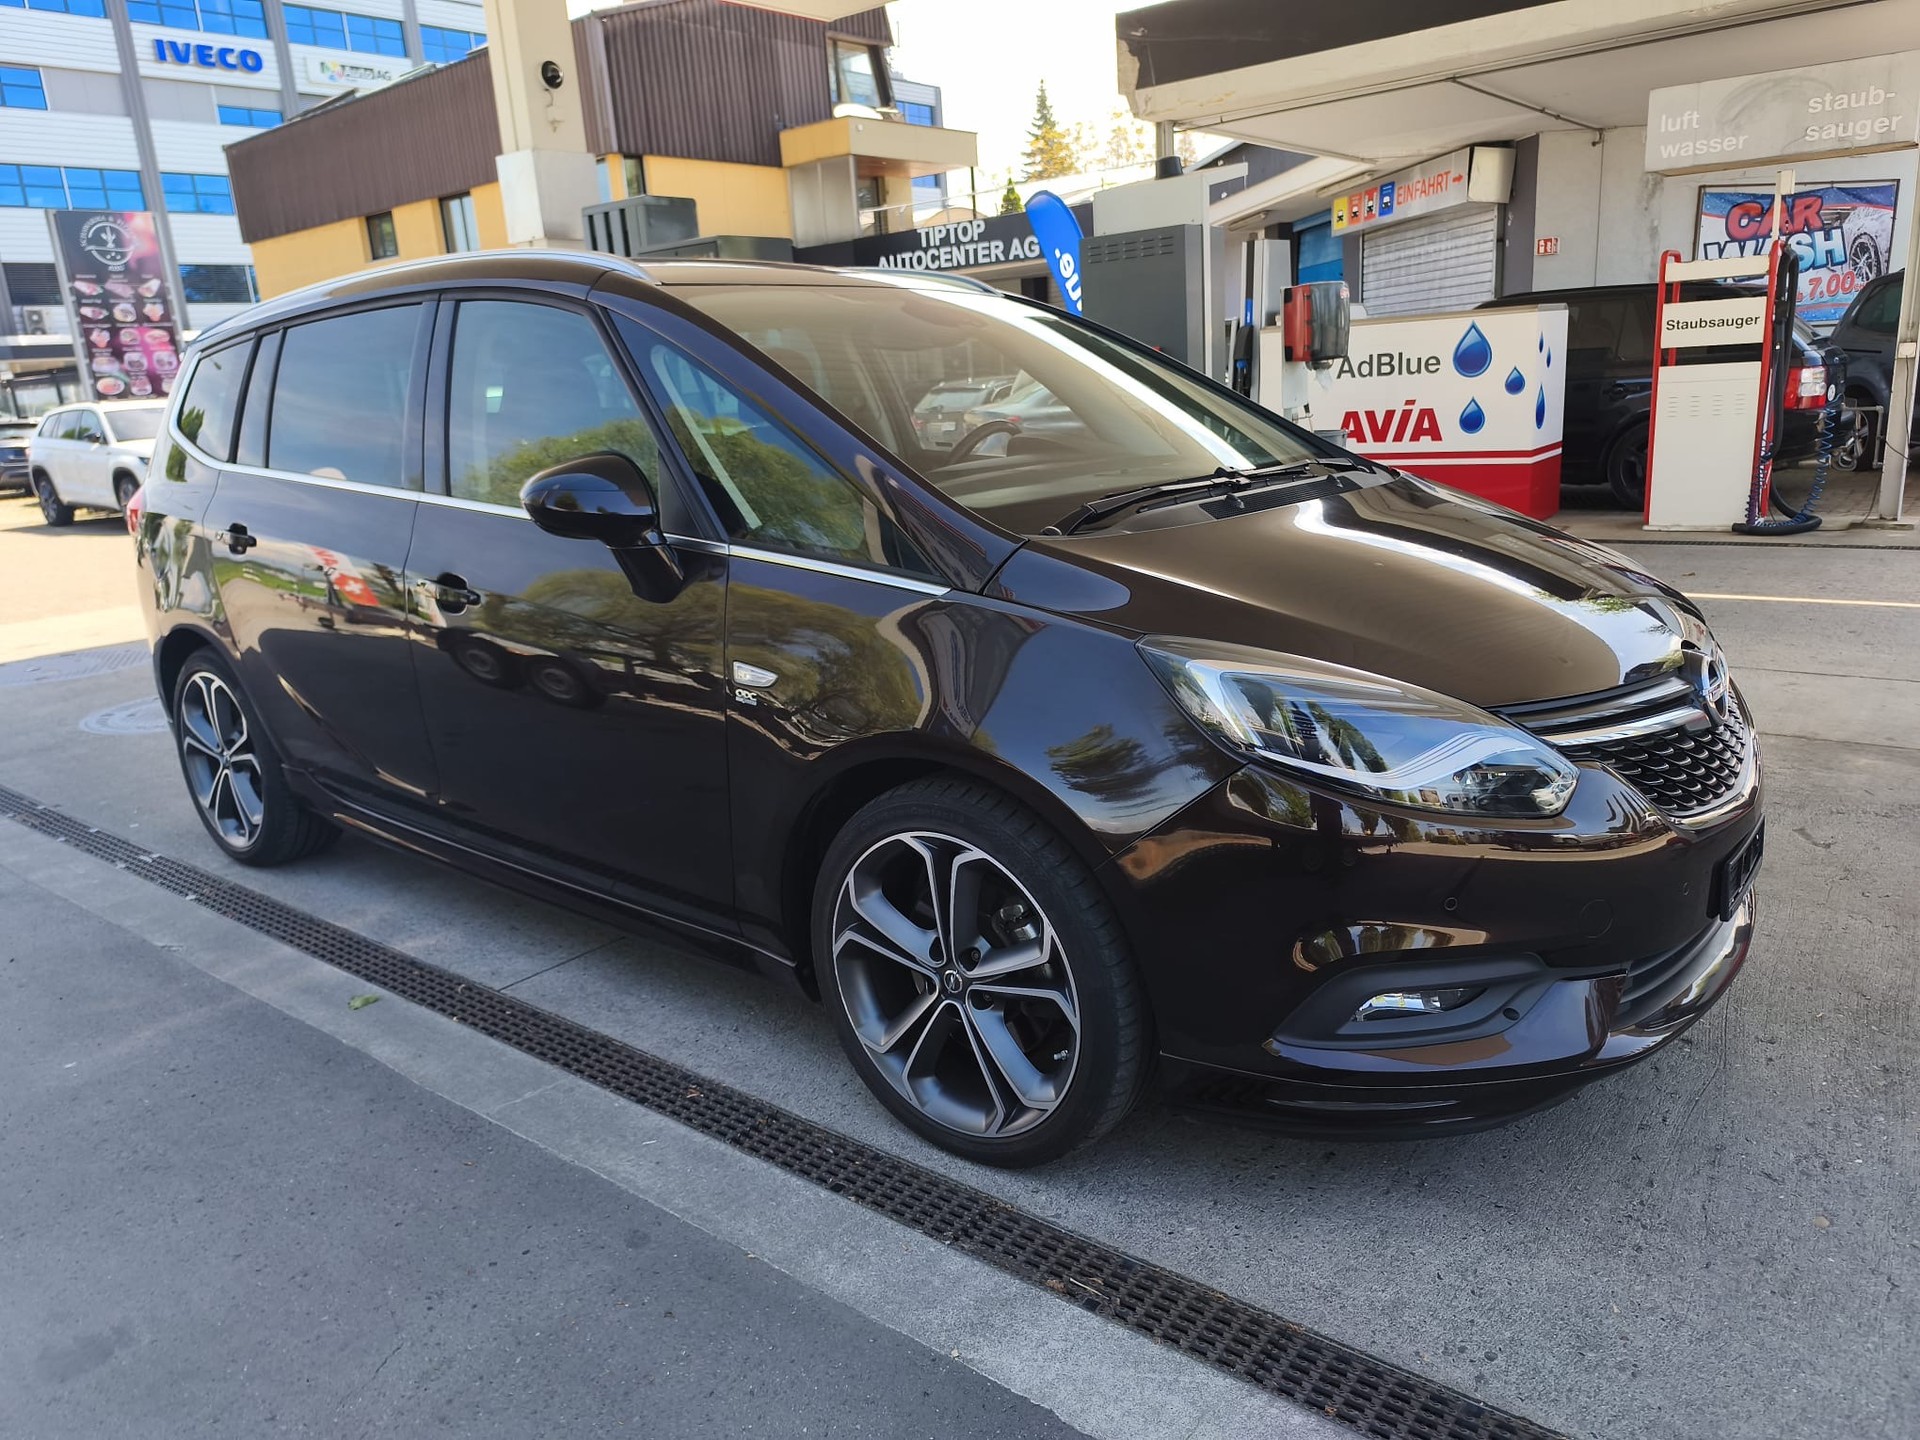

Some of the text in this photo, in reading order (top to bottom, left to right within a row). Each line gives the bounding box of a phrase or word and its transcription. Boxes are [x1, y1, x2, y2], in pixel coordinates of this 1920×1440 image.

[153, 38, 263, 74] IVECO
[1807, 85, 1897, 114] staub-
[1660, 111, 1700, 133] luft
[1804, 114, 1902, 142] sauger
[1660, 134, 1749, 159] wasser
[1396, 171, 1451, 206] EINFAHRT
[1726, 195, 1823, 241] CAR
[917, 220, 986, 247] TIPTOP
[879, 234, 1041, 271] AUTOCENTER AG
[1808, 269, 1856, 300] 7.00
[1666, 315, 1760, 331] Staubsauger
[1336, 352, 1441, 379] AdBlue
